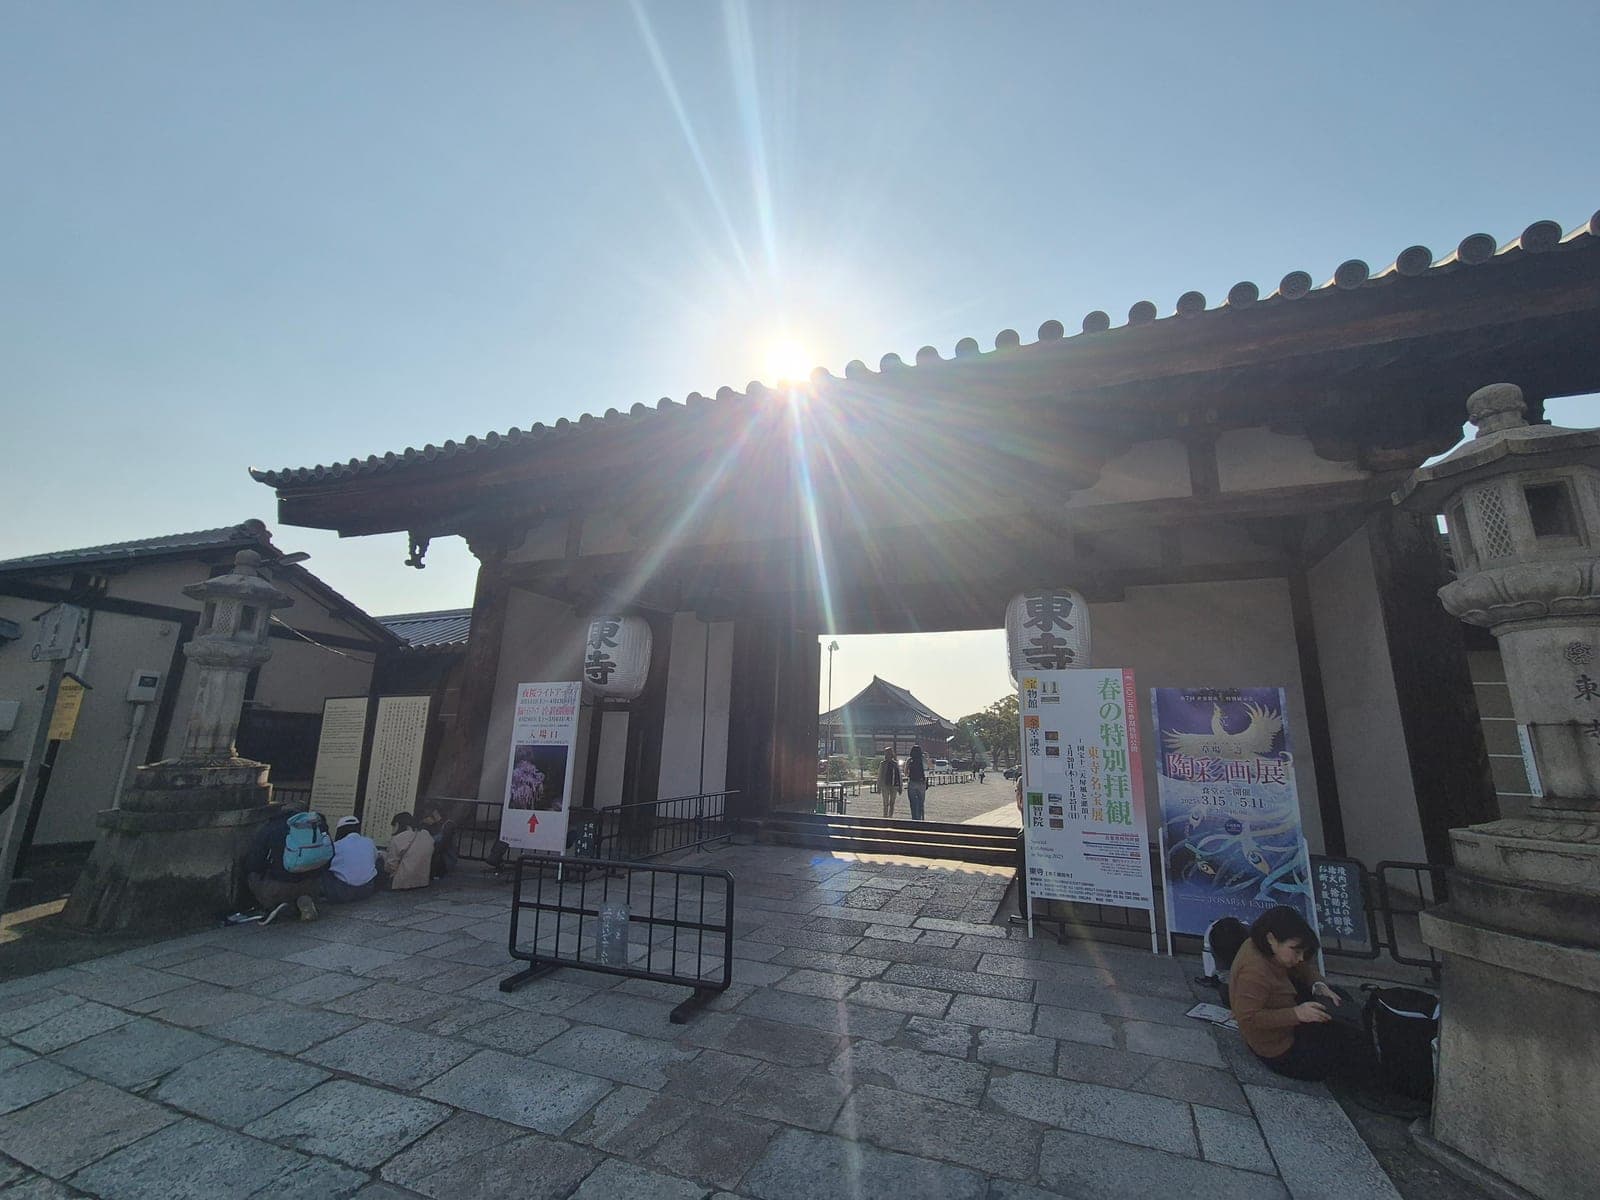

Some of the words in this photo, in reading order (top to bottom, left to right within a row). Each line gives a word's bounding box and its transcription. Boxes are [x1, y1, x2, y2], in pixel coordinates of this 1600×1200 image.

[584, 615, 623, 685] 東寺
[1022, 591, 1076, 670] 東寺
[1088, 745, 1104, 822] 東寺名宝展
[1097, 677, 1132, 826] 春の特別拝観
[1167, 752, 1286, 786] 陶彩画展
[1201, 795, 1226, 807] 3.15
